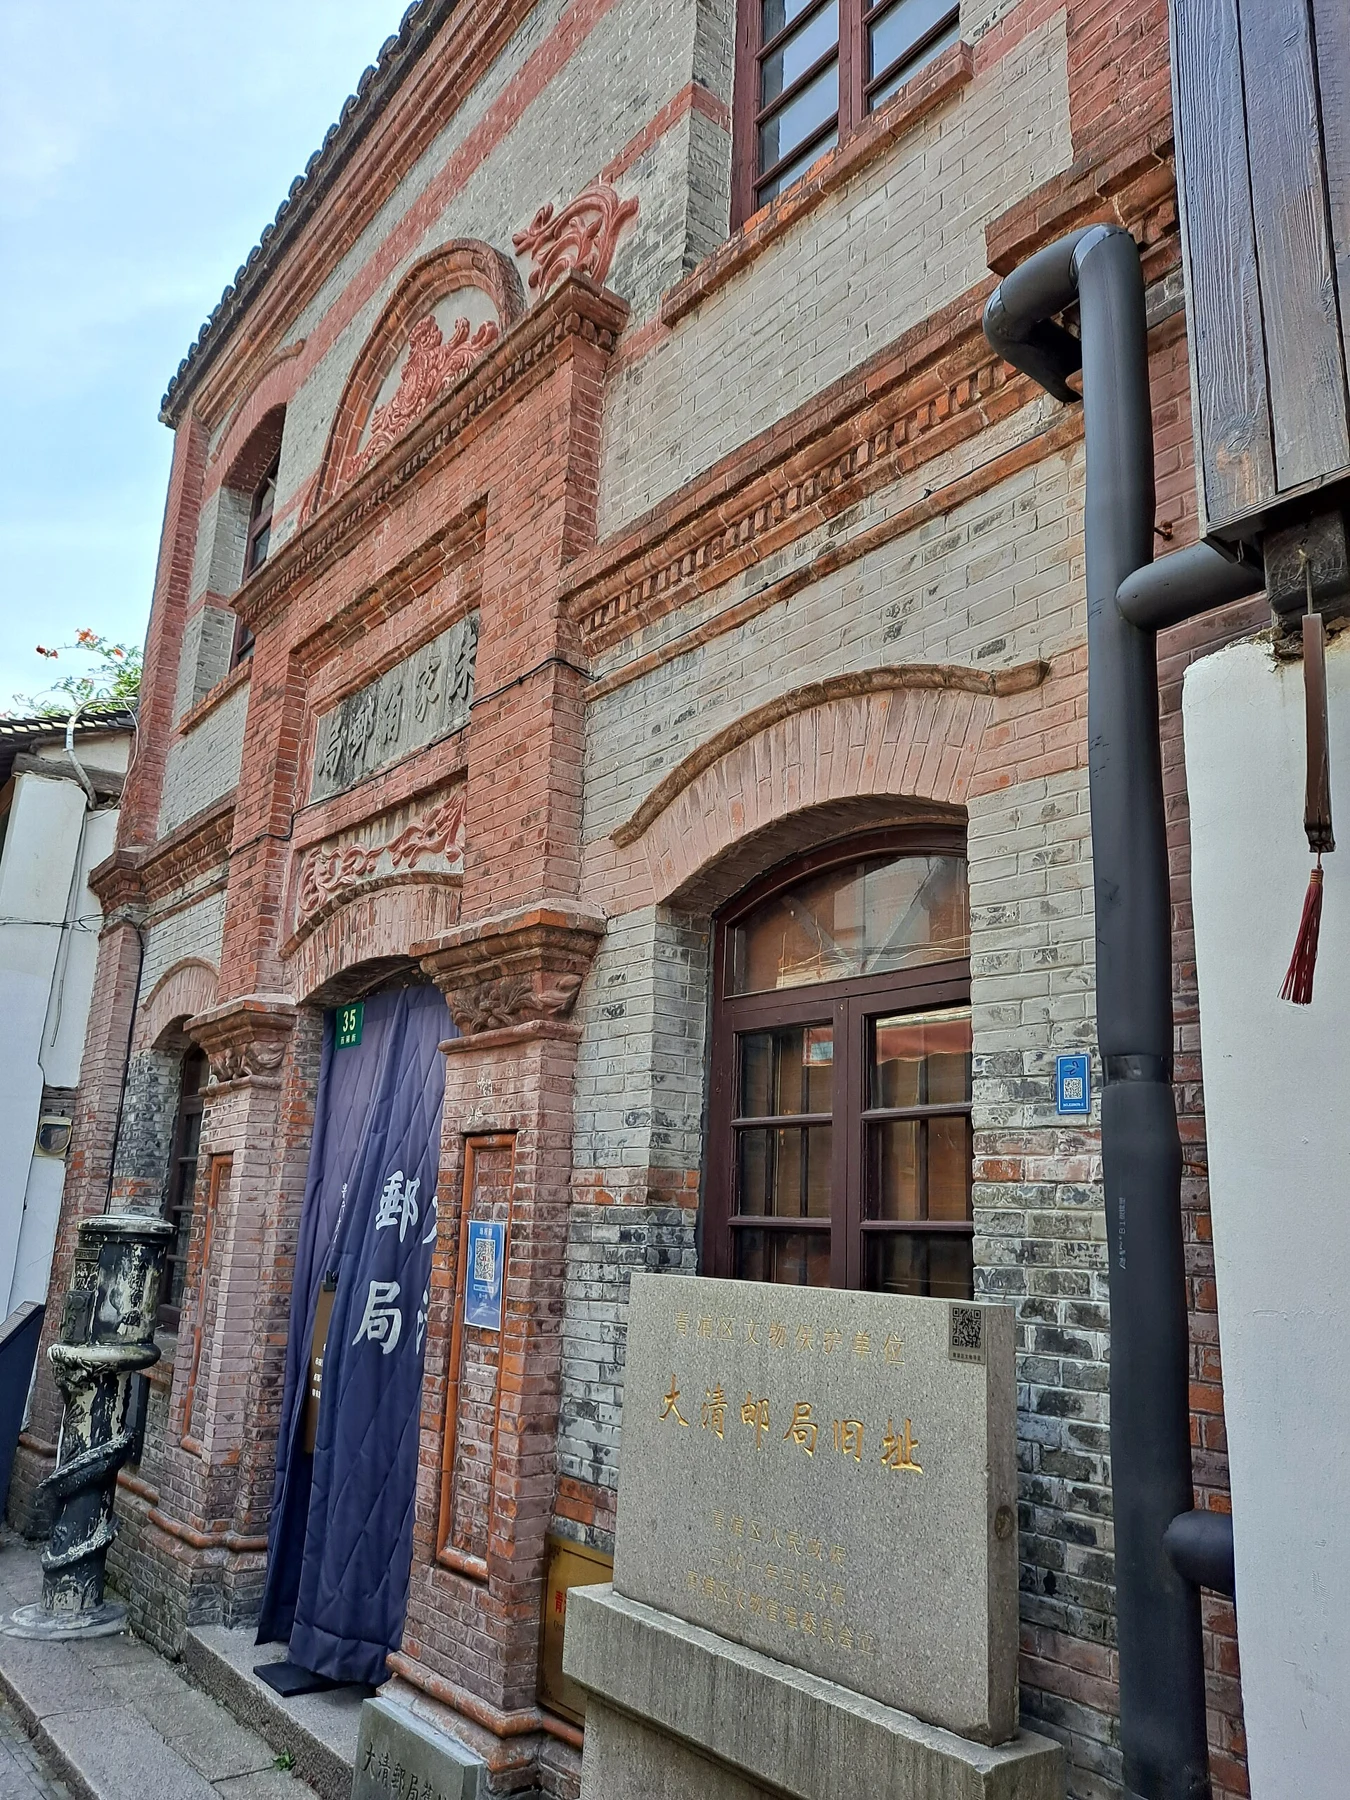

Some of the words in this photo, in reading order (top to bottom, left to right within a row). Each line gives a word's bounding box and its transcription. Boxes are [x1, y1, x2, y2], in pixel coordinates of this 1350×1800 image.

[342, 1008, 357, 1033] 35
[674, 1310, 905, 1365] 青浦区文物保护单位
[659, 1373, 924, 1474] 大清邮局旧址
[712, 1508, 847, 1568] 青浦区人民政府
